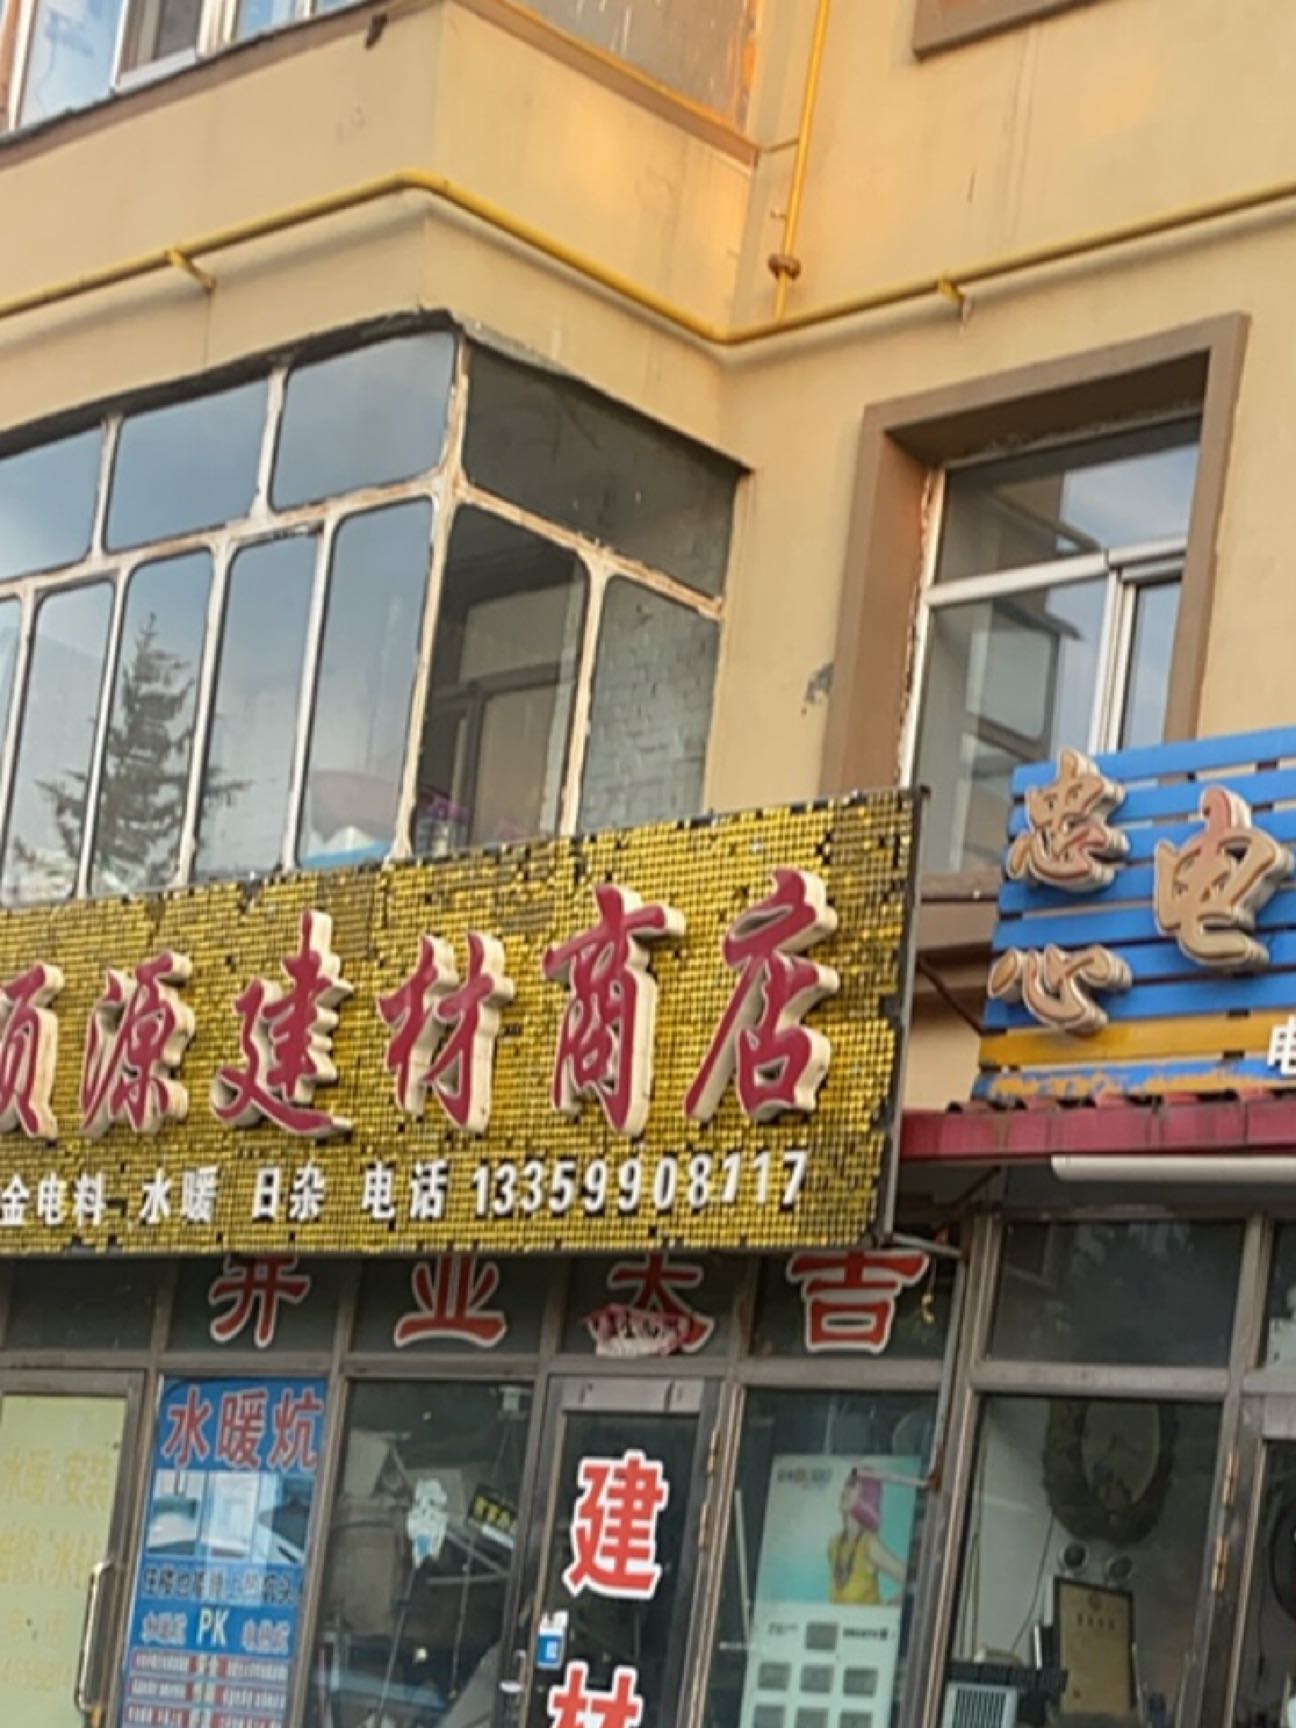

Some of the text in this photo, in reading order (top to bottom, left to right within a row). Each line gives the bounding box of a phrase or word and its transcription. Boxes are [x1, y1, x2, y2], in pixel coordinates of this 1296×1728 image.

[140, 1166, 218, 1225] 水暖
[252, 1160, 325, 1225] 日杂
[362, 1160, 448, 1223] 电话
[473, 1150, 808, 1217] 13359908117
[161, 1384, 324, 1470] 水暖炕
[196, 1608, 230, 1647] PK
